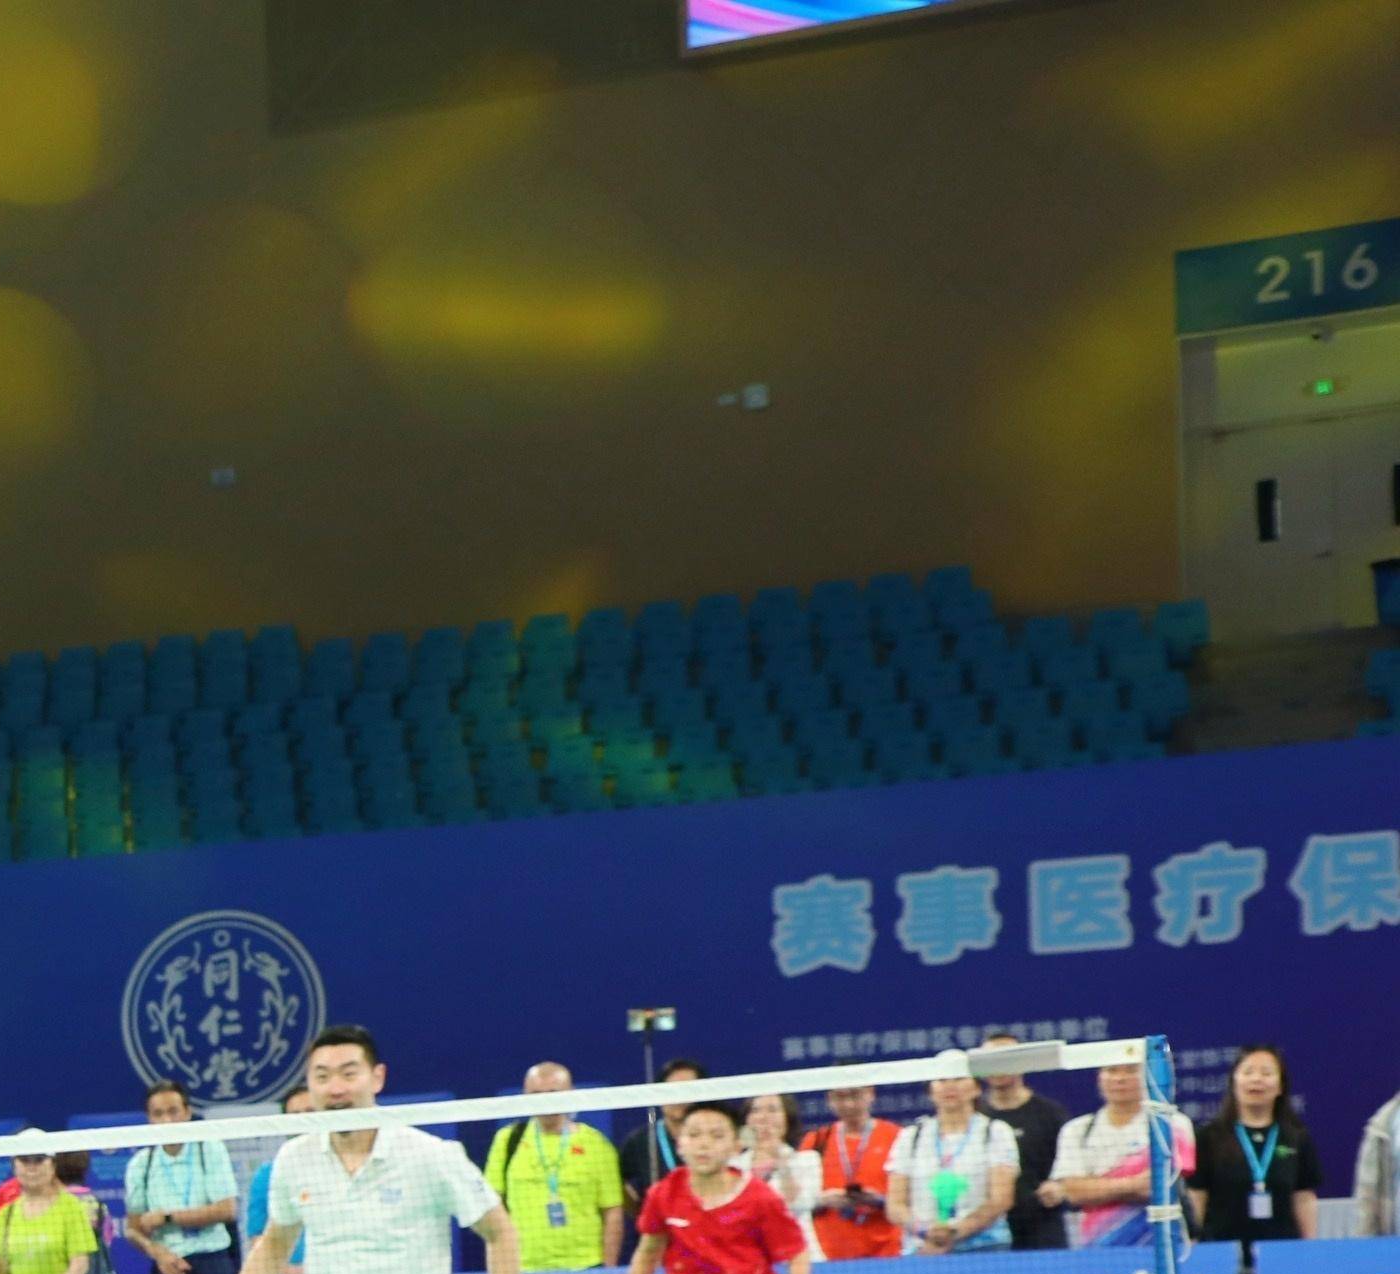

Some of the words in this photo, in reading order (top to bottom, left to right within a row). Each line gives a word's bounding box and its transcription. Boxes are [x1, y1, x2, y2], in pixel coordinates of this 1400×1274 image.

[1254, 243, 1380, 303] 216
[770, 829, 1400, 978] 赛事医疗保
